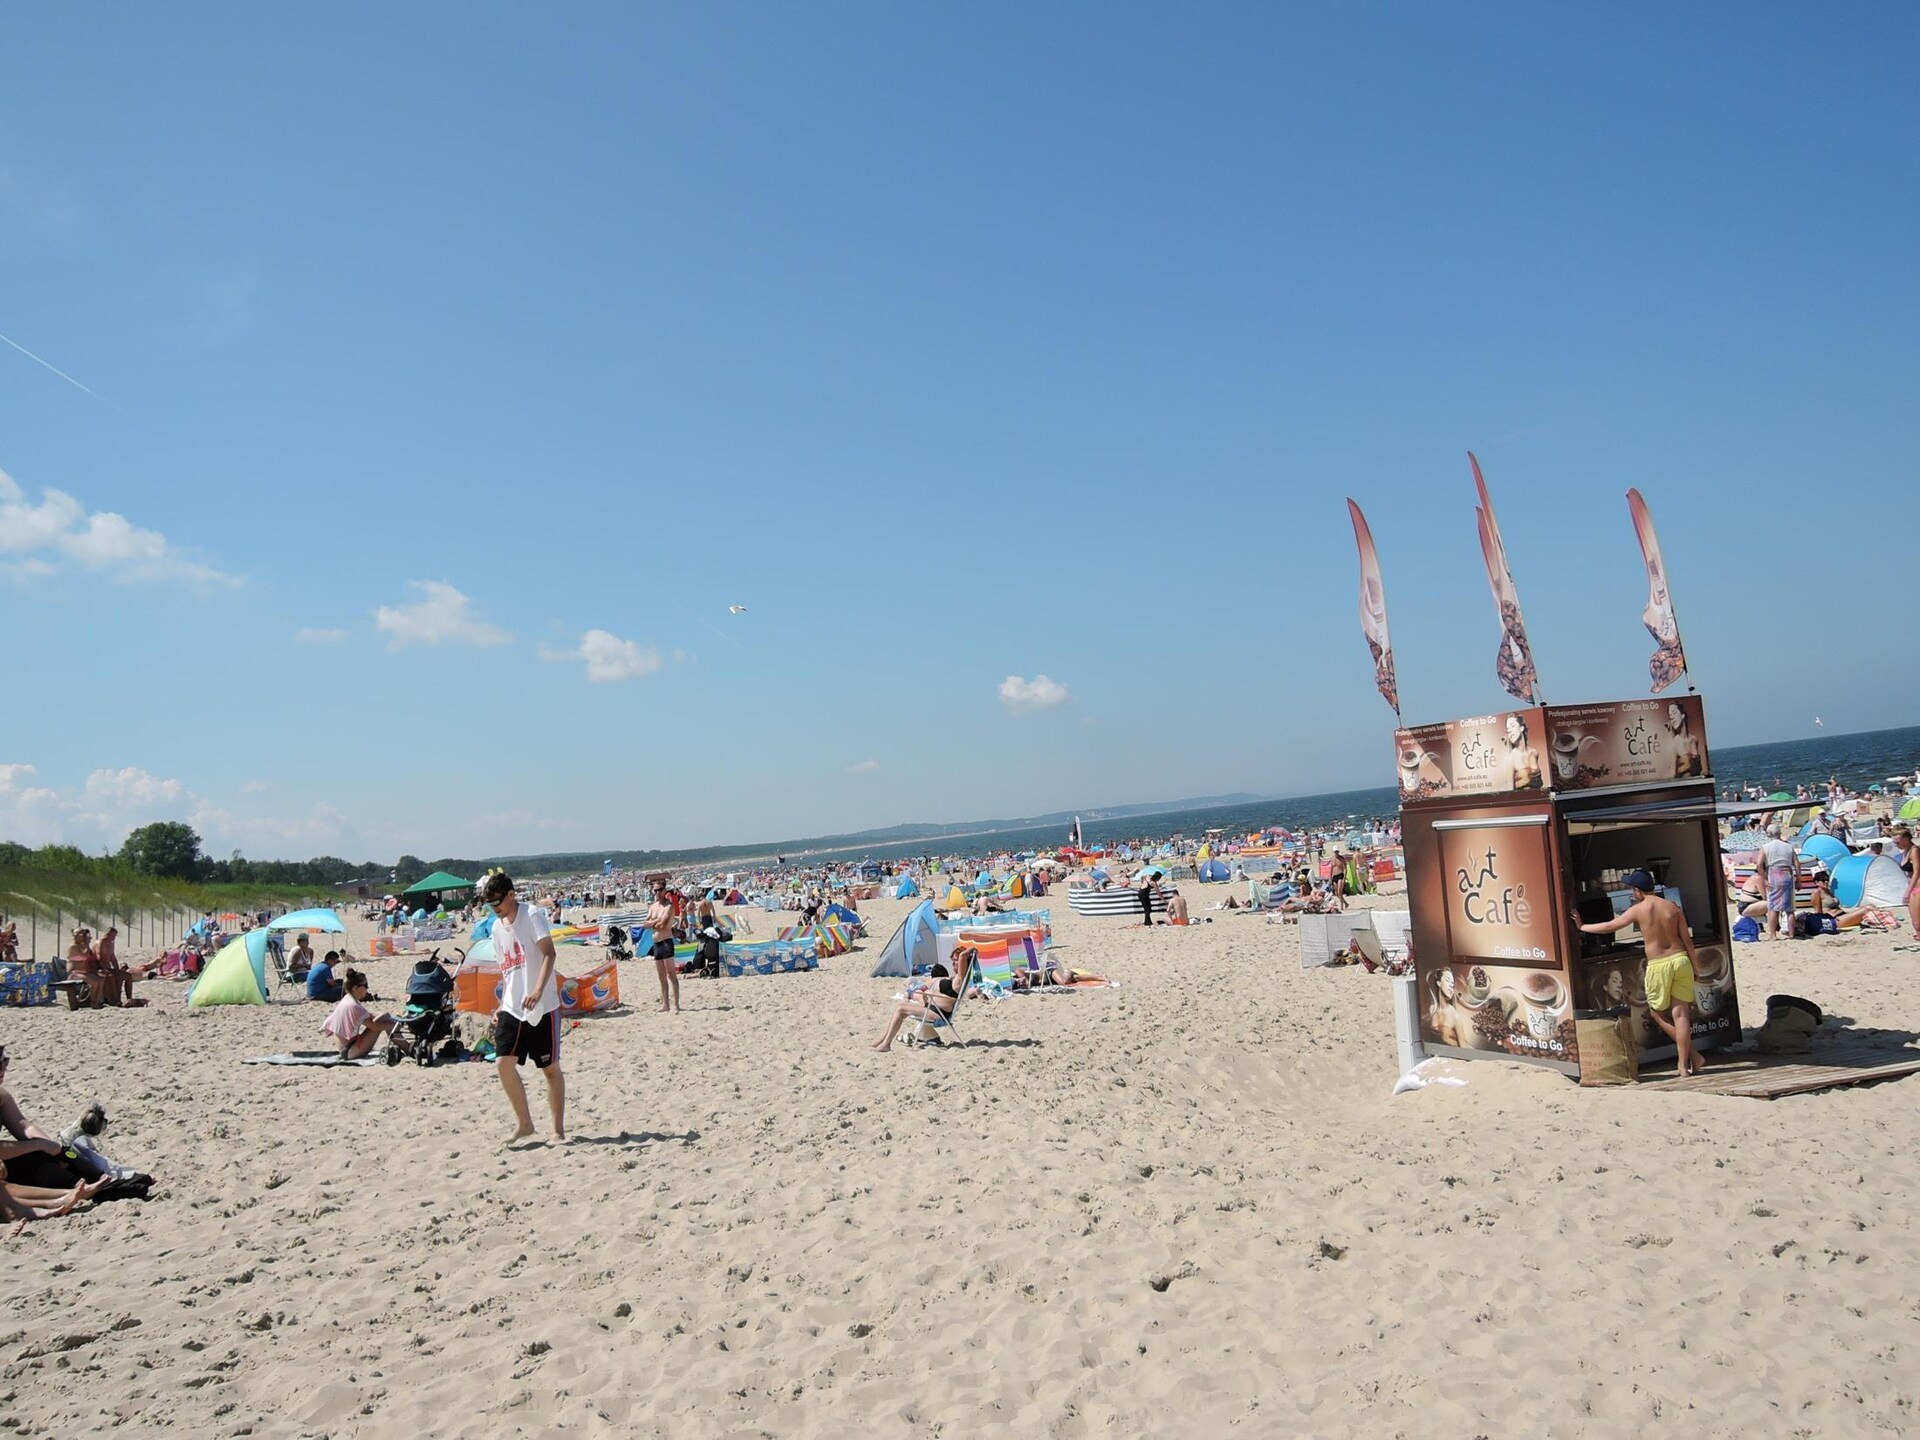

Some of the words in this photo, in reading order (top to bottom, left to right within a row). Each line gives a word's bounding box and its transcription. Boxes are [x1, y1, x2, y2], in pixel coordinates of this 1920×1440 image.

[1622, 703, 1641, 712] Coffee
[1642, 702, 1649, 710] to
[1650, 701, 1659, 710] Go
[1460, 718, 1479, 728] Coffee
[1480, 717, 1487, 726] to
[1487, 715, 1497, 724] Go
[1623, 715, 1645, 741] art
[1462, 730, 1482, 755] art
[1628, 733, 1661, 756] Café
[1465, 747, 1497, 770] Café
[1457, 845, 1498, 893] art
[1464, 884, 1532, 925] Café
[1494, 945, 1521, 957] Coffee
[1522, 947, 1531, 958] to
[1533, 947, 1546, 959] Go
[1708, 1020, 1717, 1030] to
[1718, 1017, 1730, 1028] Go
[1510, 1034, 1538, 1048] Coffee
[1539, 1038, 1548, 1050] to
[1549, 1039, 1563, 1051] Go
